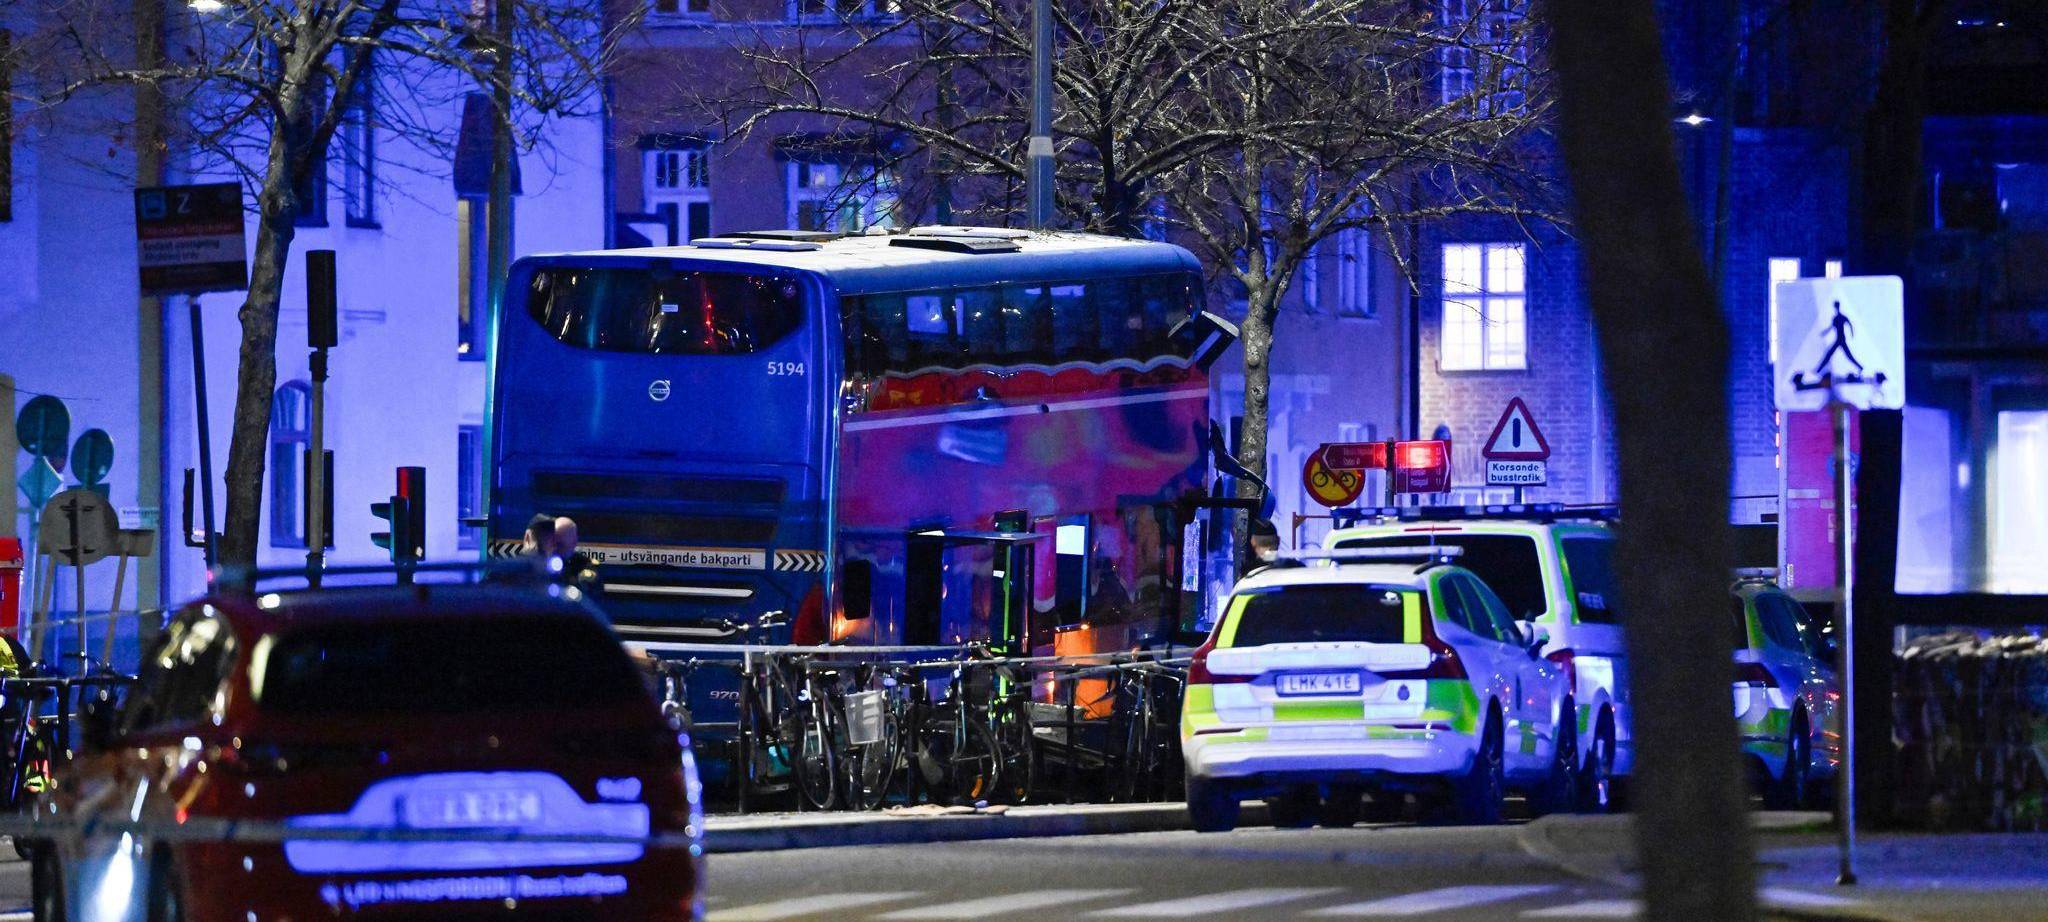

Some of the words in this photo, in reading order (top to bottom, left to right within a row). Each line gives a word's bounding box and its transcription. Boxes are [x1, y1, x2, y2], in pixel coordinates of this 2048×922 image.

[178, 192, 191, 213] Z
[767, 361, 805, 376] 5194
[1492, 463, 1540, 471] Korsande
[1491, 473, 1541, 481] busstrafik
[620, 550, 697, 566] utsvängande
[701, 552, 751, 567] bakparti
[1289, 676, 1318, 690] LMK
